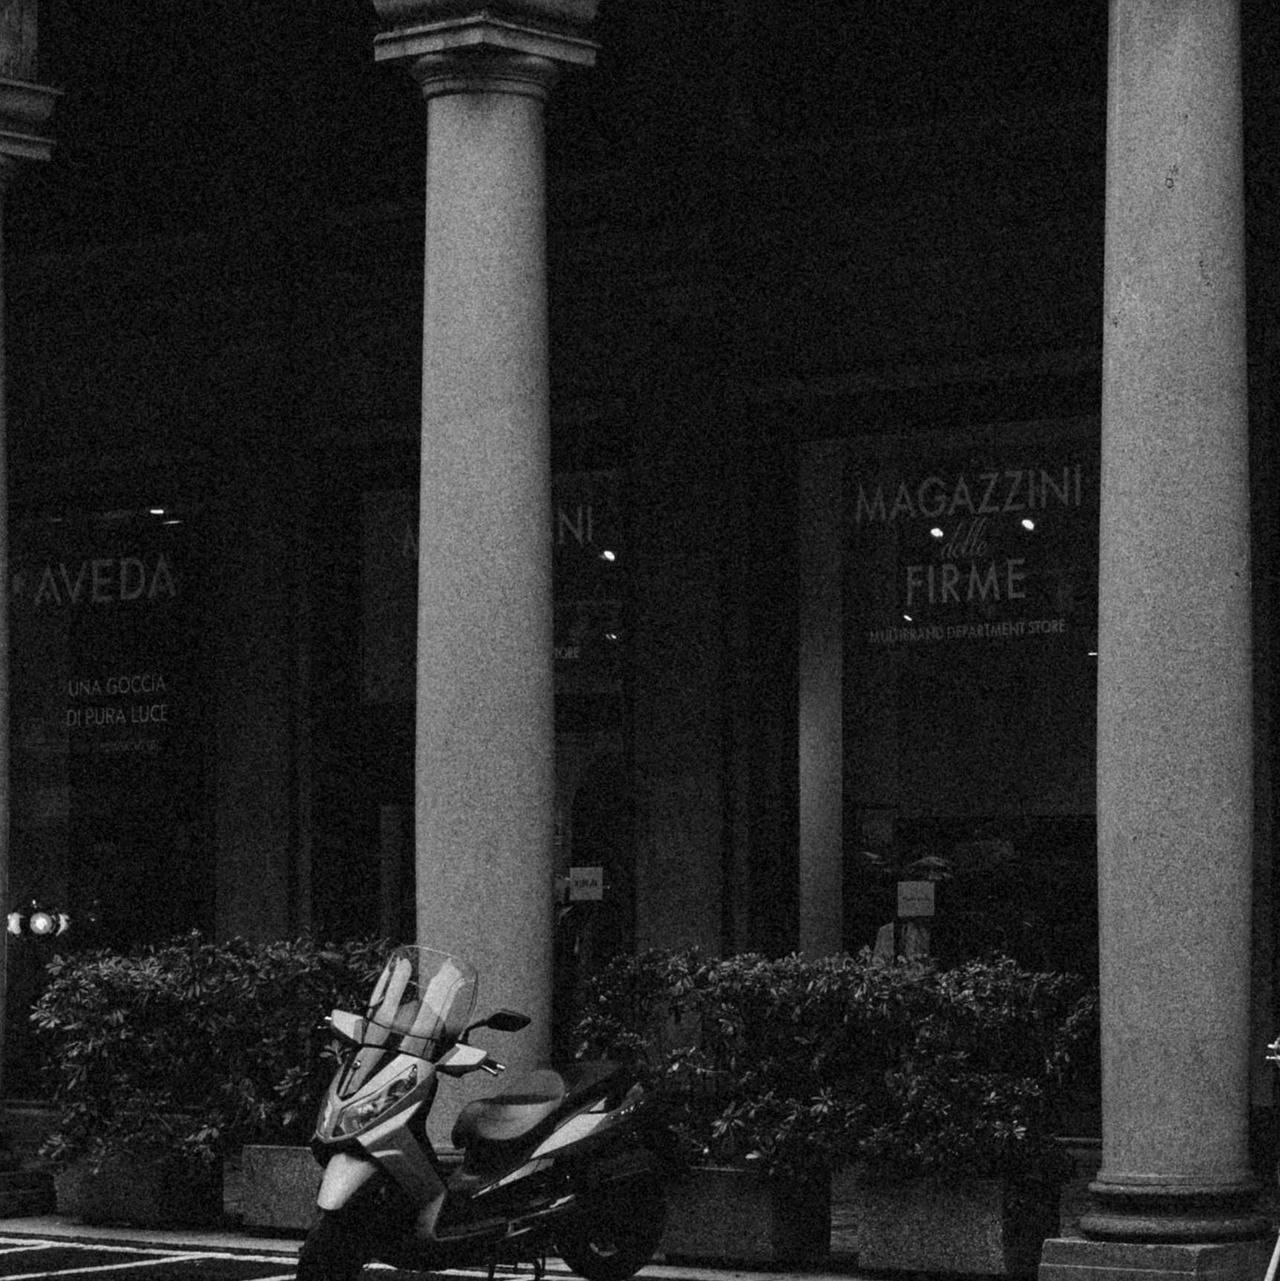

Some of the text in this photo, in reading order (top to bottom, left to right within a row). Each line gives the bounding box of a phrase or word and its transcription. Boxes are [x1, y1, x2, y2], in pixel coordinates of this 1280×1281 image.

[854, 463, 1082, 523] MAGAZZINI
[34, 553, 177, 607] AVEDA
[905, 558, 1026, 606] FIRME
[946, 621, 1026, 639] DEPARTMENT
[1027, 618, 1066, 634] STORE
[67, 674, 167, 697] UNA GOCCIA
[65, 703, 168, 727] DI PURA LUCE
